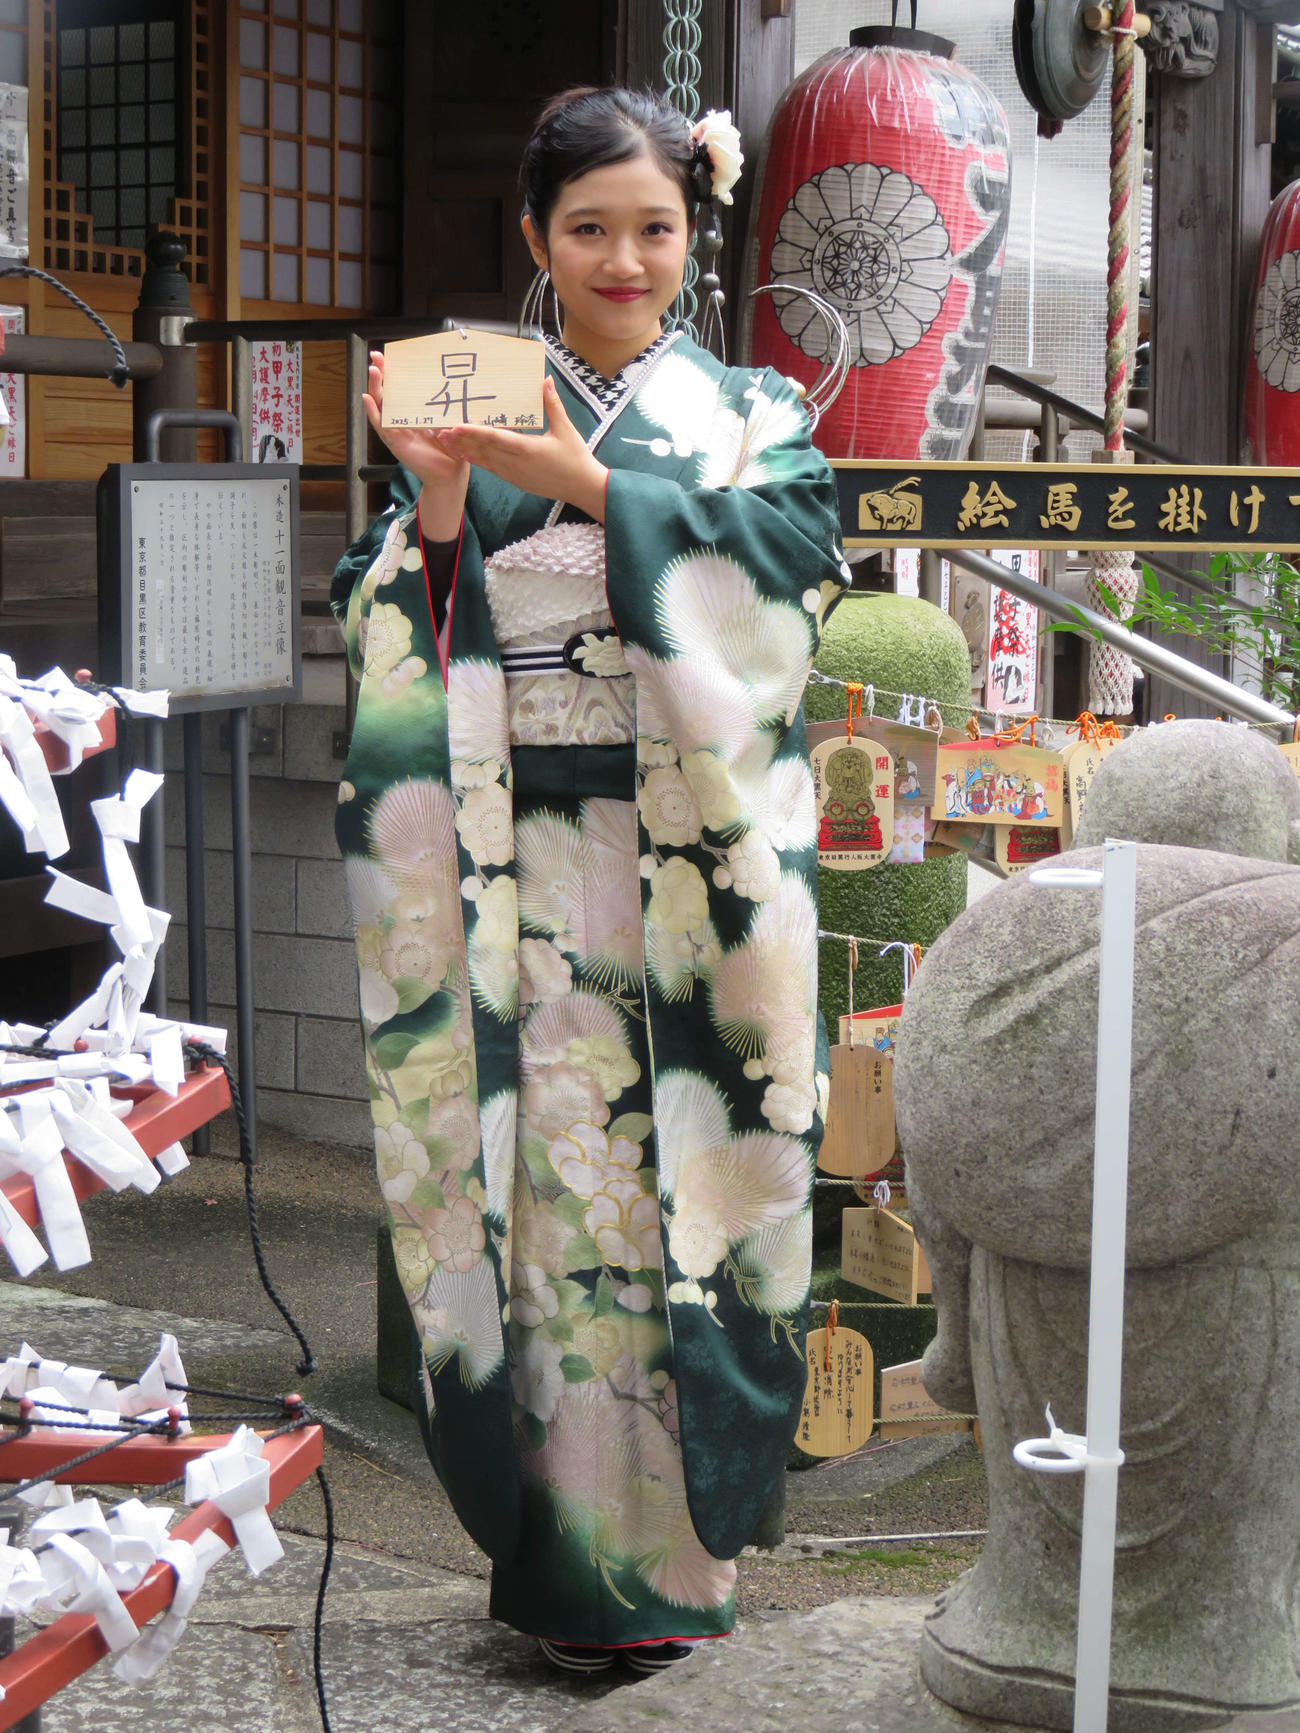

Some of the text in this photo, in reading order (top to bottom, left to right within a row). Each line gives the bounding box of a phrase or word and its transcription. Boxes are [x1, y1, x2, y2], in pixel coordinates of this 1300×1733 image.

[271, 342, 284, 434] 初甲子祭
[956, 480, 1300, 535] 絵馬を掛け
[275, 494, 287, 656] 木造十一面観音立像
[875, 756, 890, 799] 開運
[873, 1060, 882, 1095] お願い事
